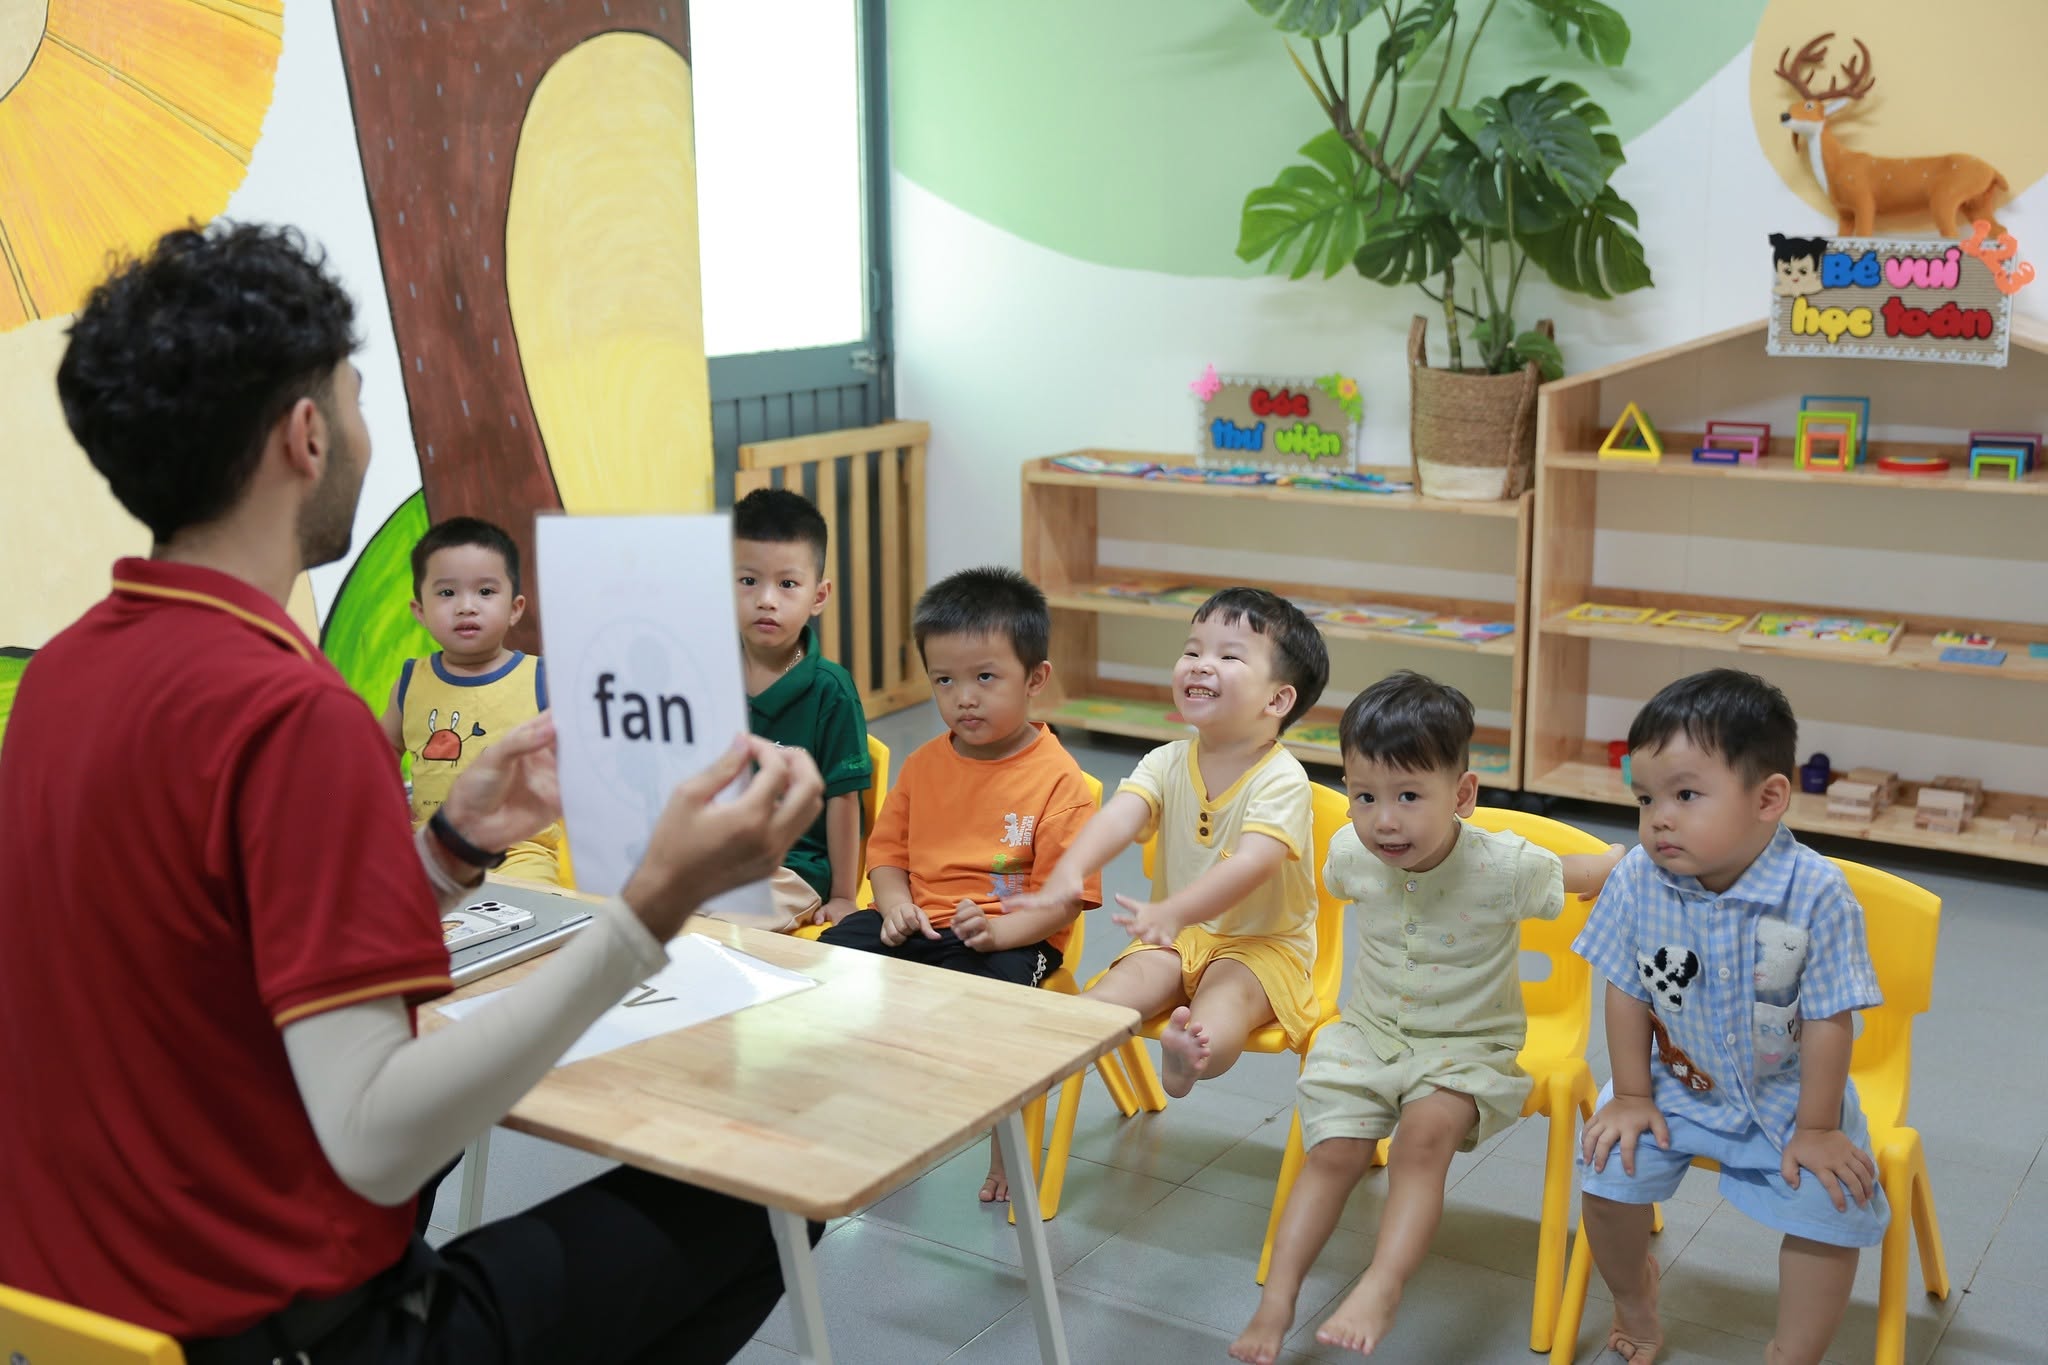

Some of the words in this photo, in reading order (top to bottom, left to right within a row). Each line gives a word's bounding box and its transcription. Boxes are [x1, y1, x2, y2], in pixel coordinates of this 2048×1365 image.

[1822, 250, 1880, 288] Bé
[1885, 247, 1961, 289] vui
[1791, 296, 1873, 344] học
[1881, 296, 1993, 339] toán
[1274, 422, 1341, 462] viện
[593, 672, 694, 744] fan
